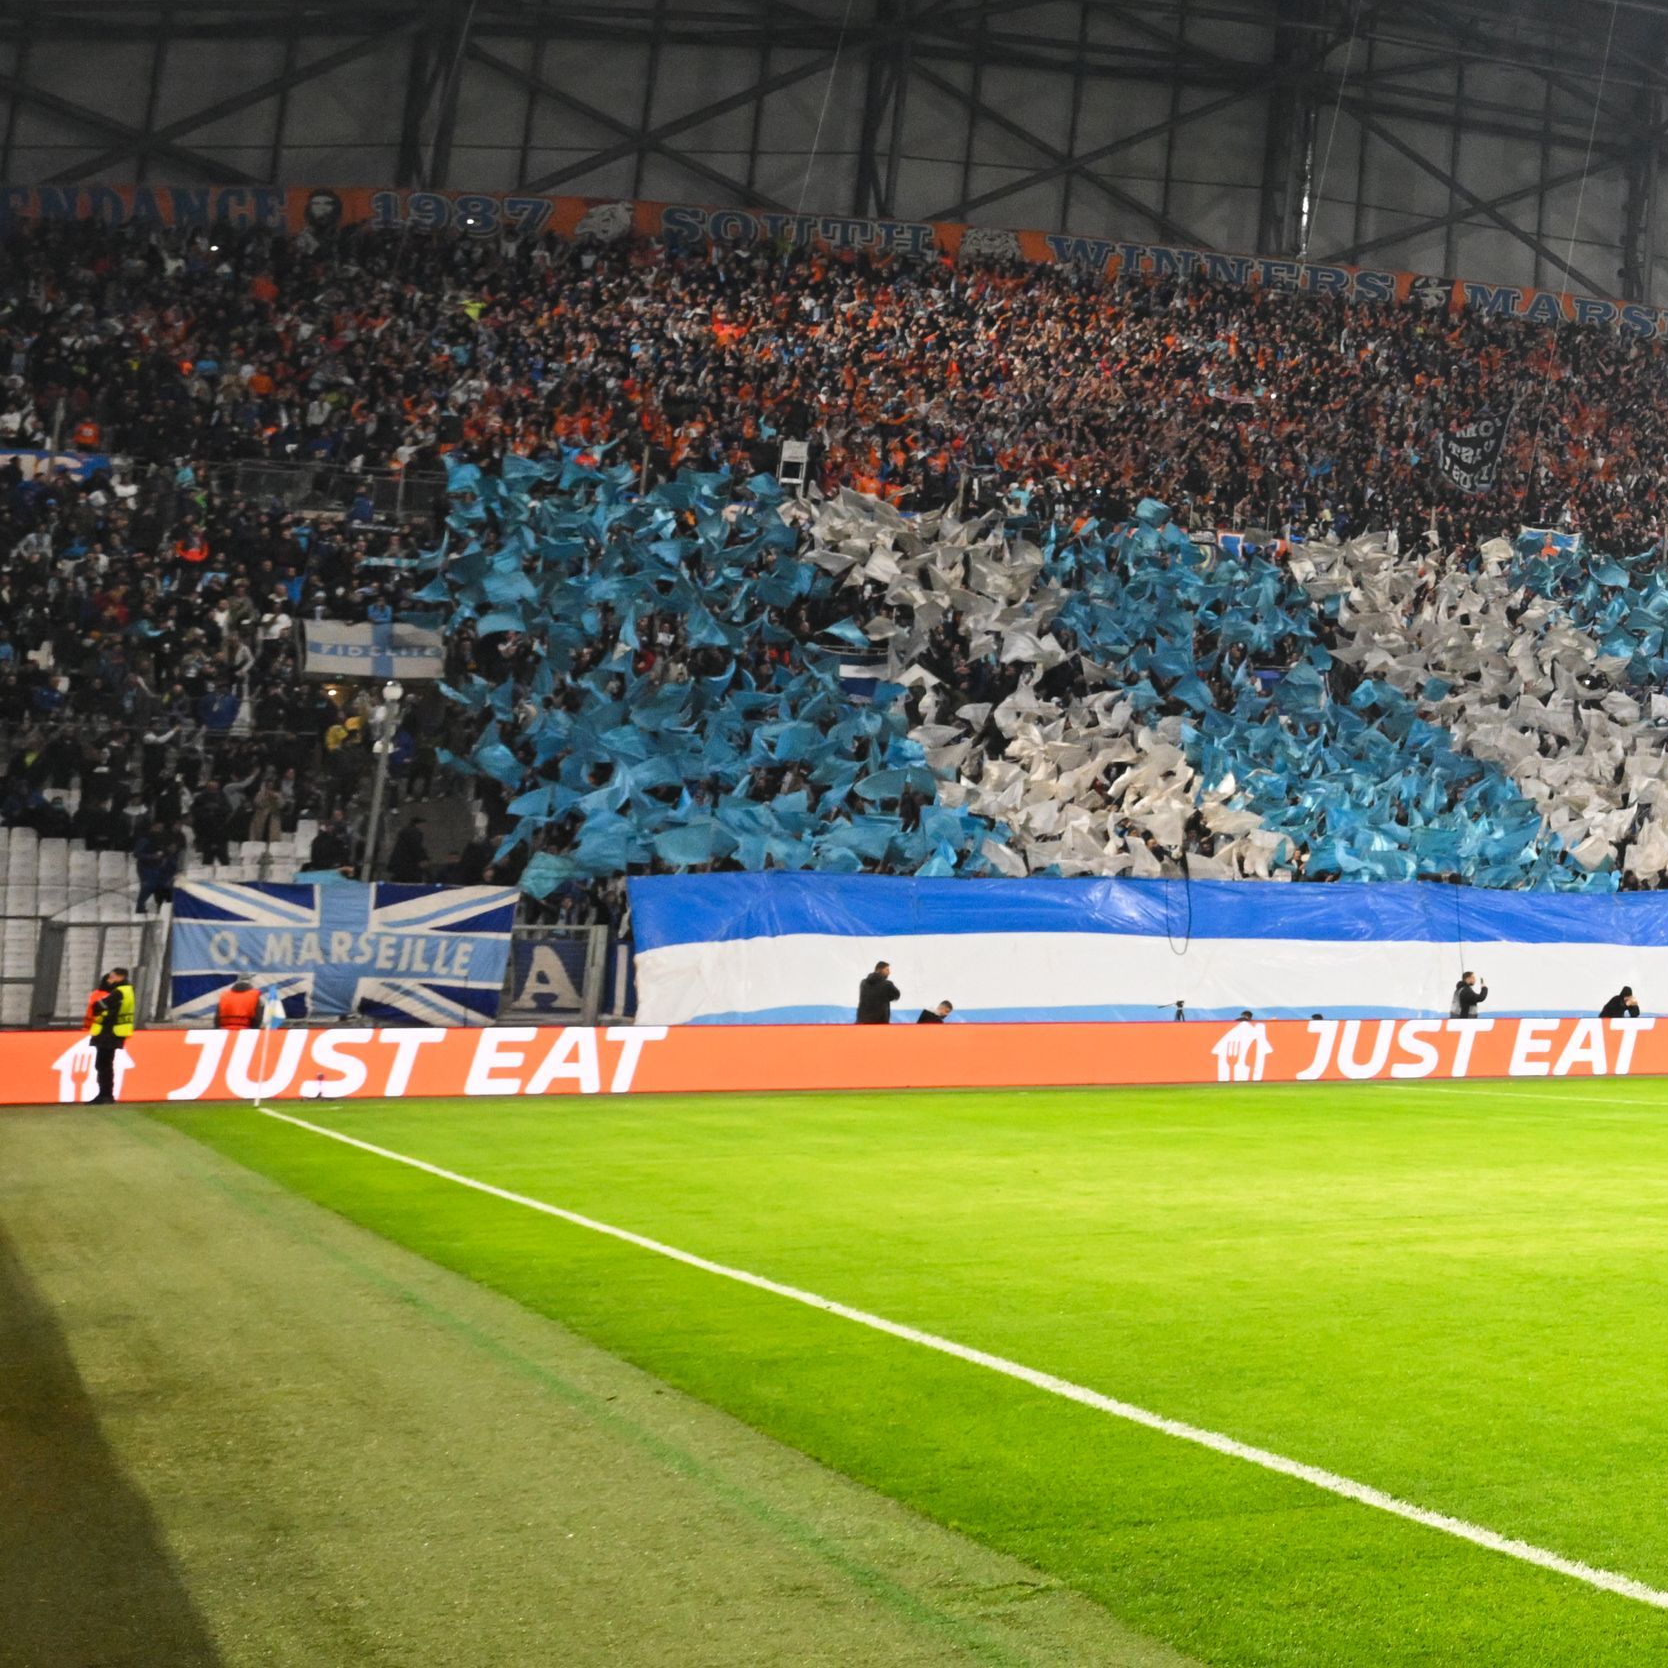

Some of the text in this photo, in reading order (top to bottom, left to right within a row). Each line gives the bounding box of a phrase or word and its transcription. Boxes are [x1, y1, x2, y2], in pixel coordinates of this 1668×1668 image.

[372, 191, 556, 238] 1987
[662, 205, 1398, 302] SOUTH WINNERS
[210, 929, 474, 986] O. MARSEILLE
[168, 1026, 668, 1100] JUST EAT
[1296, 1017, 1655, 1081] JUST EAT
